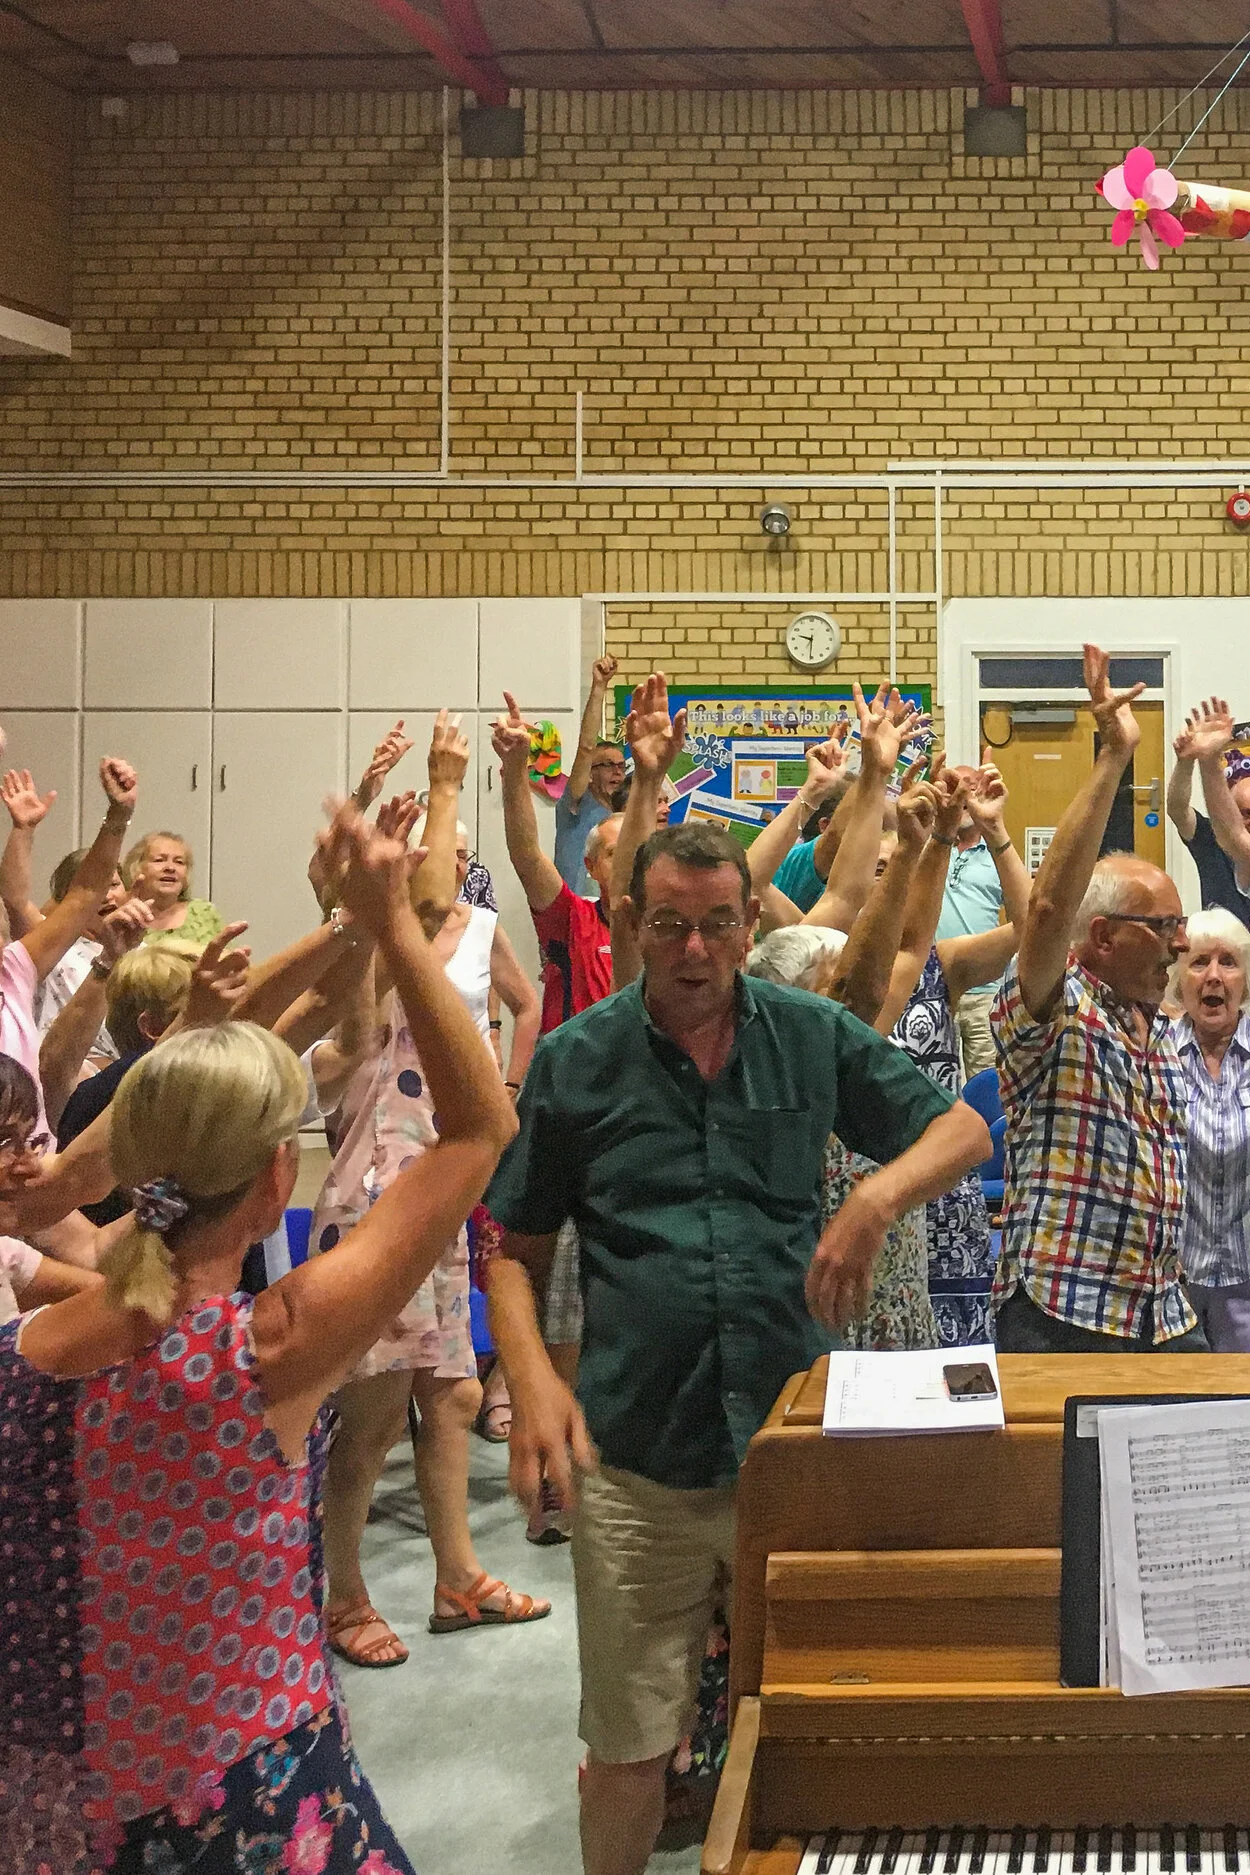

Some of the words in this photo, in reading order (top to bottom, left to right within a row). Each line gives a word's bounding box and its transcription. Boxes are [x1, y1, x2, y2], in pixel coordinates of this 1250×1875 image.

[689, 711, 720, 721] This
[722, 711, 757, 721] looks
[760, 711, 785, 721] like
[788, 712, 798, 721] a
[800, 710, 822, 723] job
[685, 743, 729, 759] SPLASH
